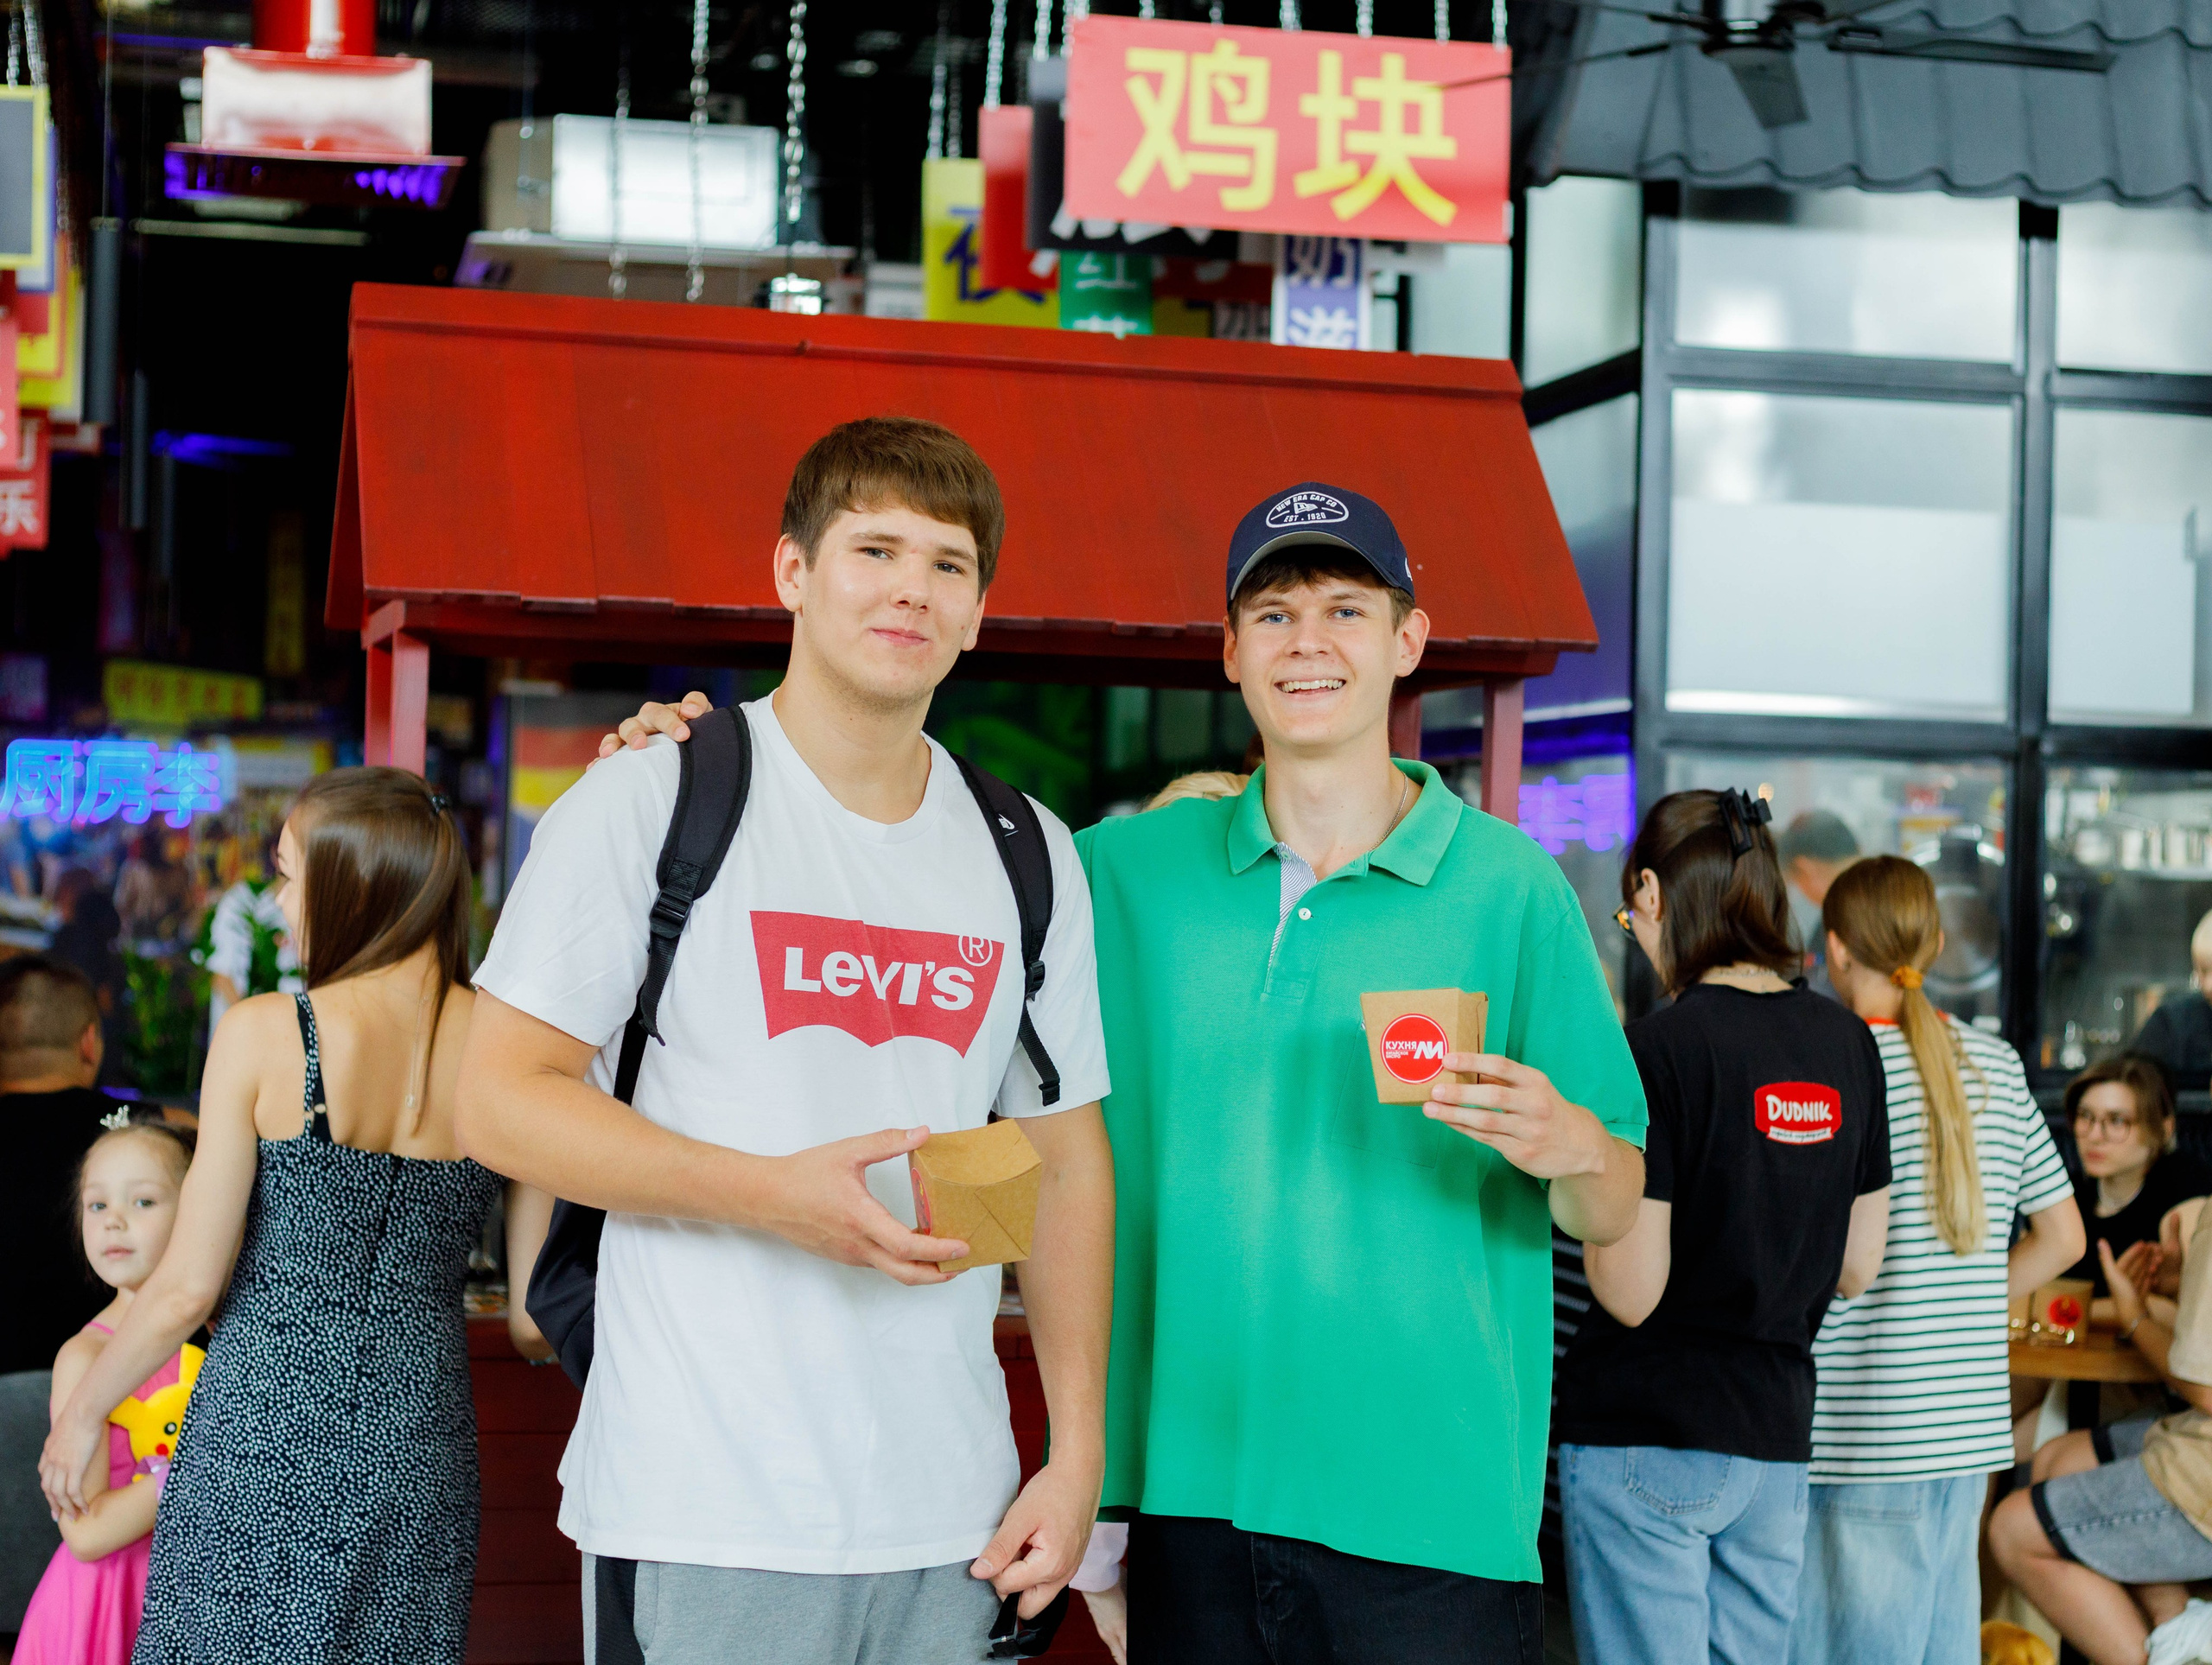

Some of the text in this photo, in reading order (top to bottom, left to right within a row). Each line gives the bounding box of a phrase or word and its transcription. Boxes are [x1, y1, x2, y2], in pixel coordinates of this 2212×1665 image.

[1116, 38, 1459, 227] 鸡块
[1275, 499, 1291, 512] NEW
[1325, 499, 1337, 507] CO
[1307, 512, 1326, 520] 1920
[1385, 1040, 1417, 1050] КУХНЯ
